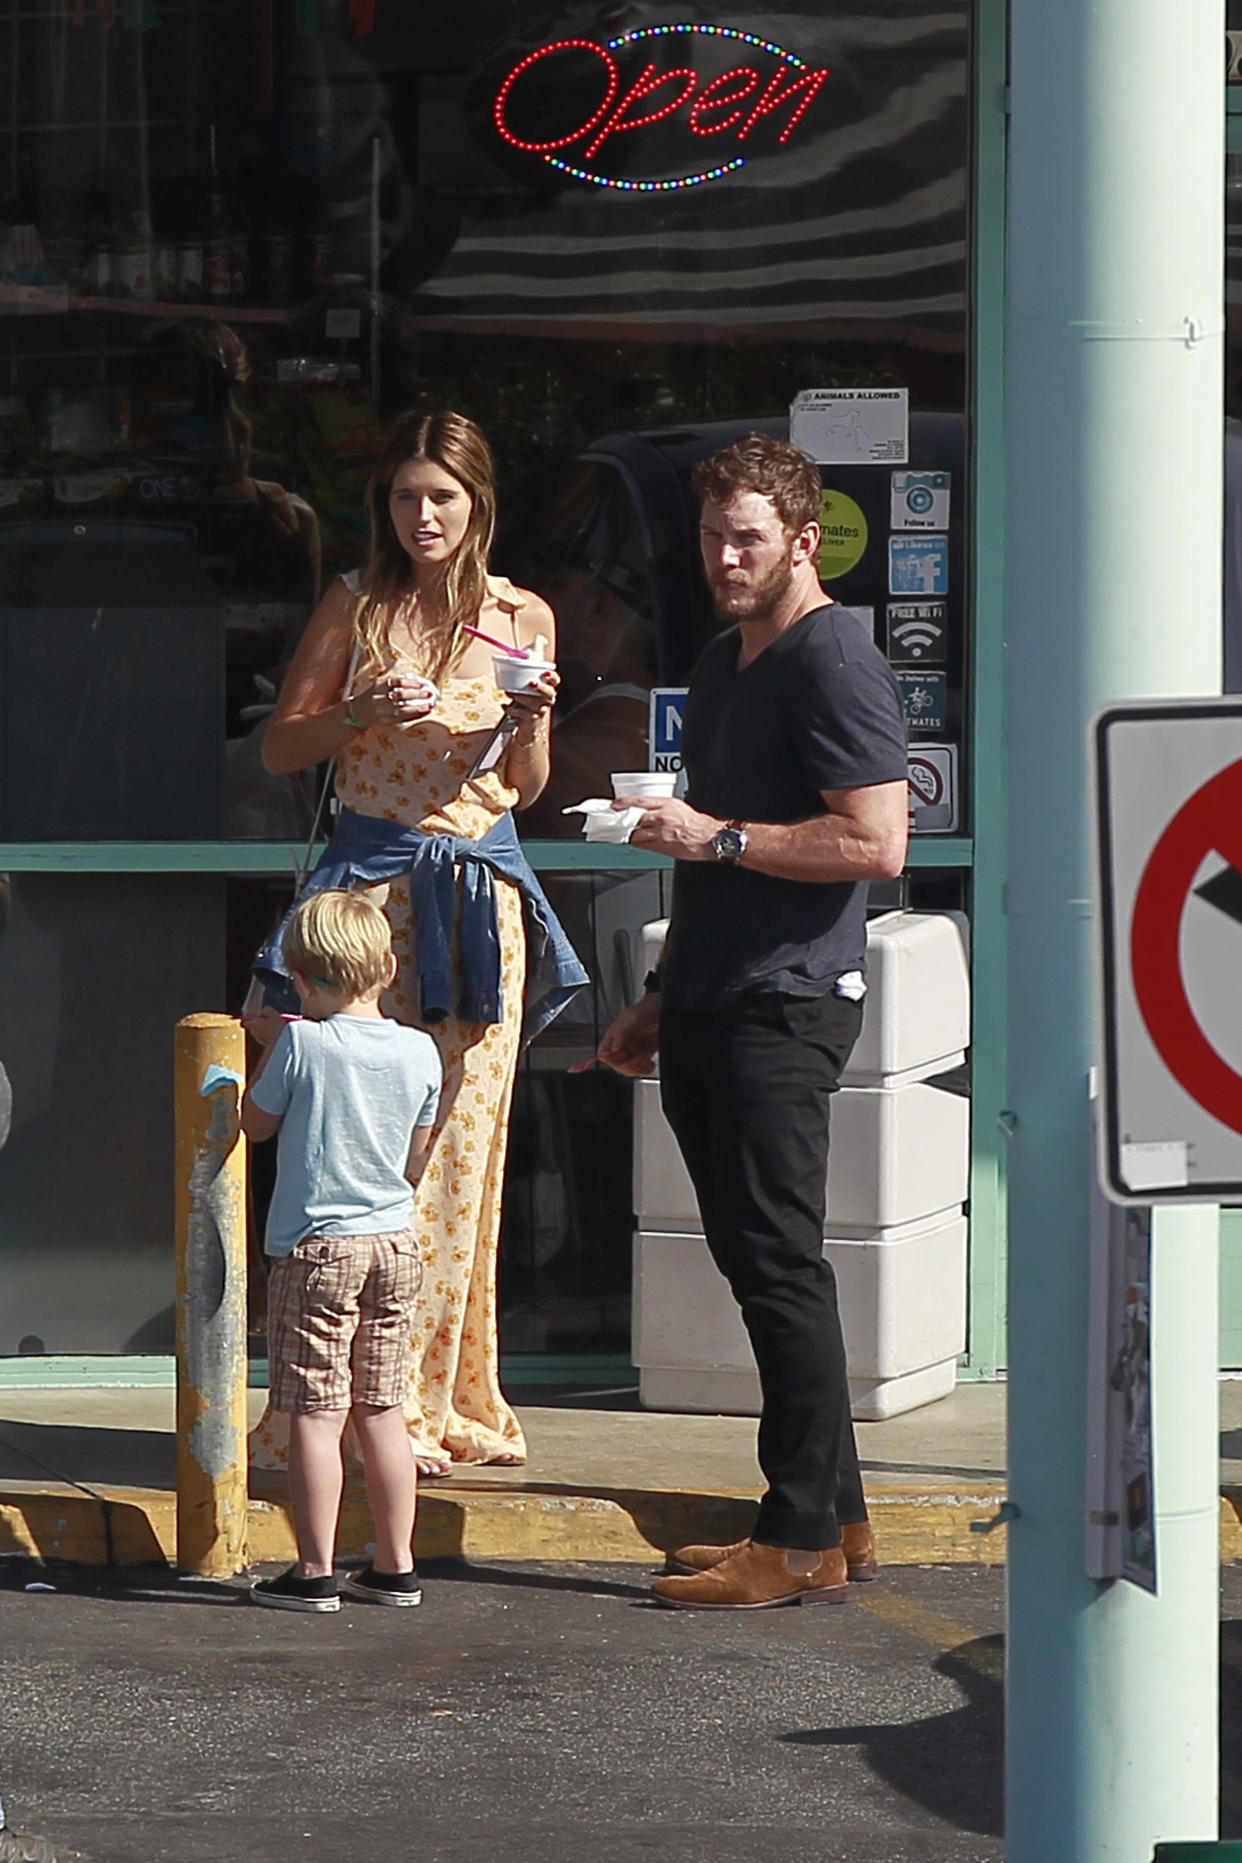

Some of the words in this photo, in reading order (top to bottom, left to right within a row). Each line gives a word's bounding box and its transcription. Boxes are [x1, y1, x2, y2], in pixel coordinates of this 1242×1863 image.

[494, 38, 832, 160] Open
[814, 392, 854, 400] ANIMALS
[857, 392, 900, 400] ALLOWED
[140, 477, 177, 498] ONE
[904, 519, 925, 527] Follow
[891, 608, 915, 619] FREE
